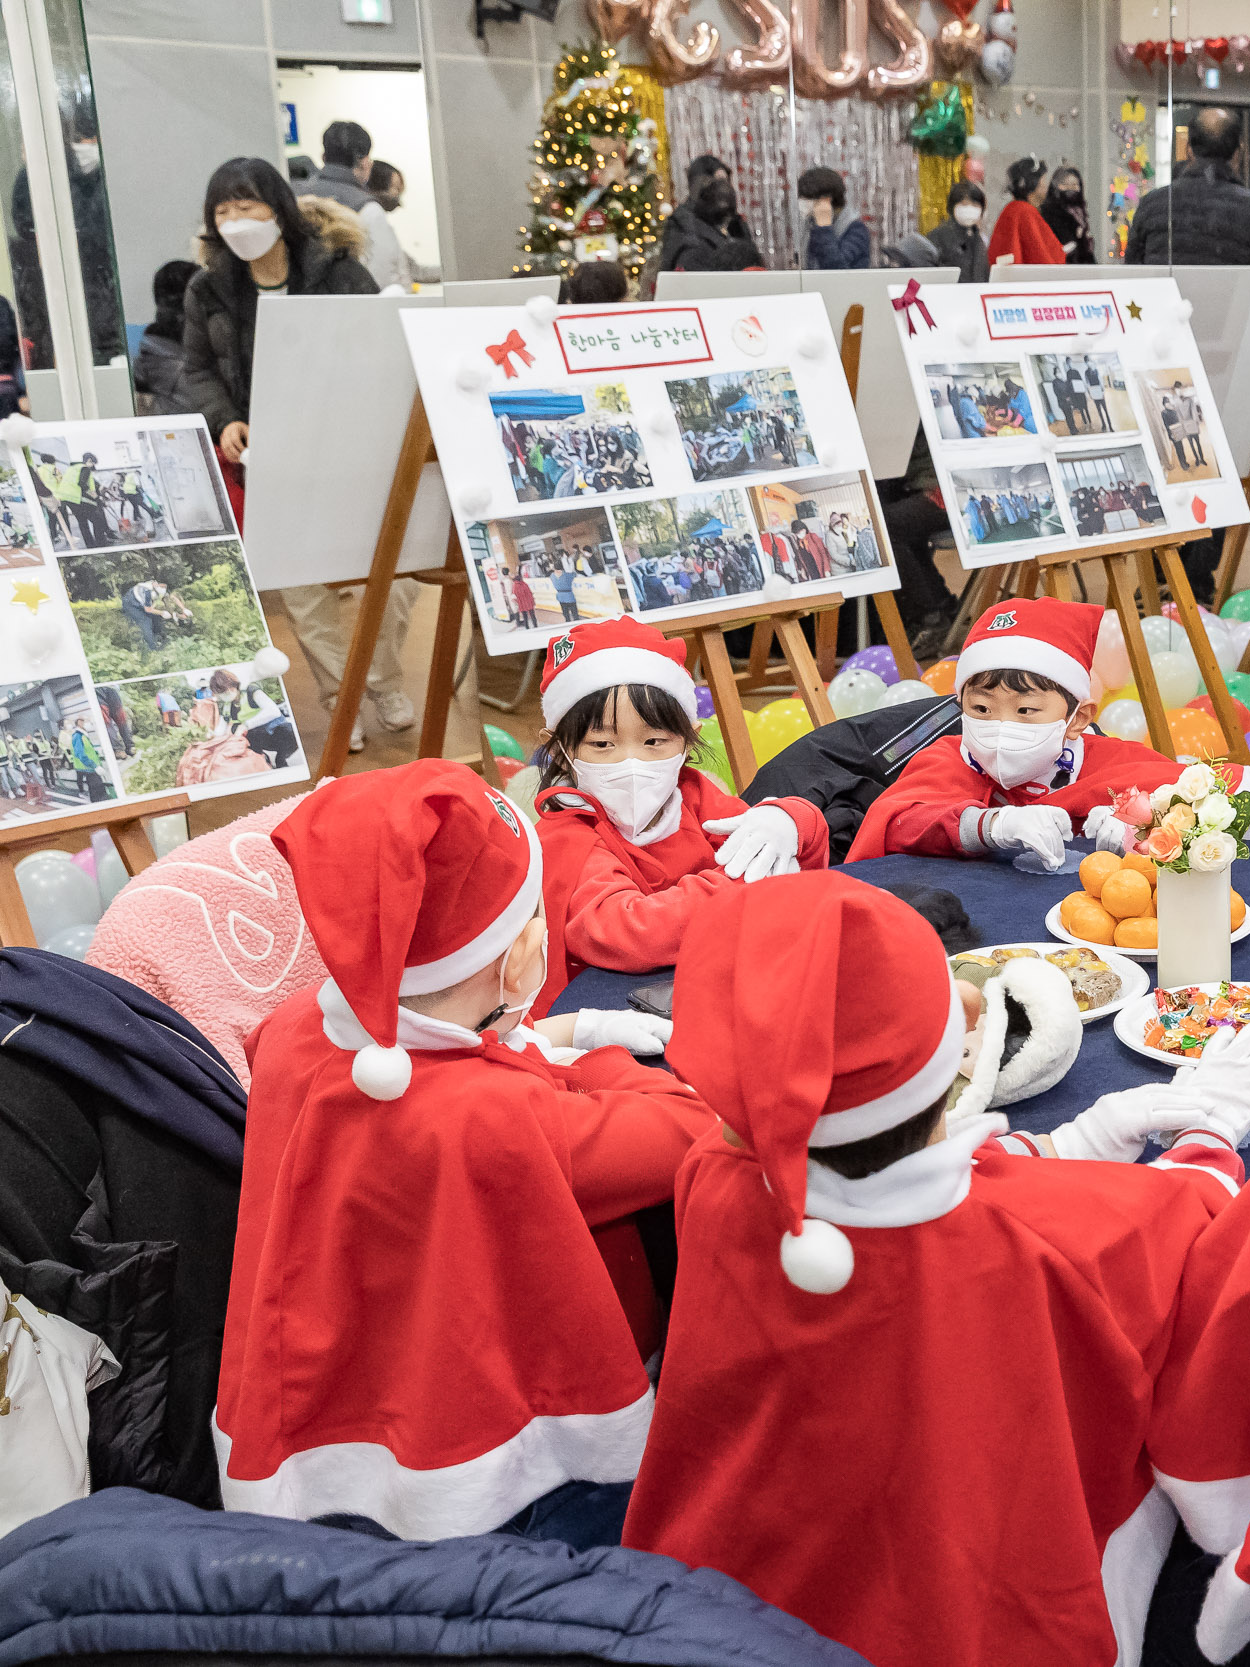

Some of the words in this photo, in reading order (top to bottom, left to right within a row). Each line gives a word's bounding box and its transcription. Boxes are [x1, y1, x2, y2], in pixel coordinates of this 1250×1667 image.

[992, 308, 1028, 324] 사랑의
[1031, 306, 1077, 322] 김장김치
[567, 328, 621, 352] 한마음
[631, 326, 700, 349] 나눔장터
